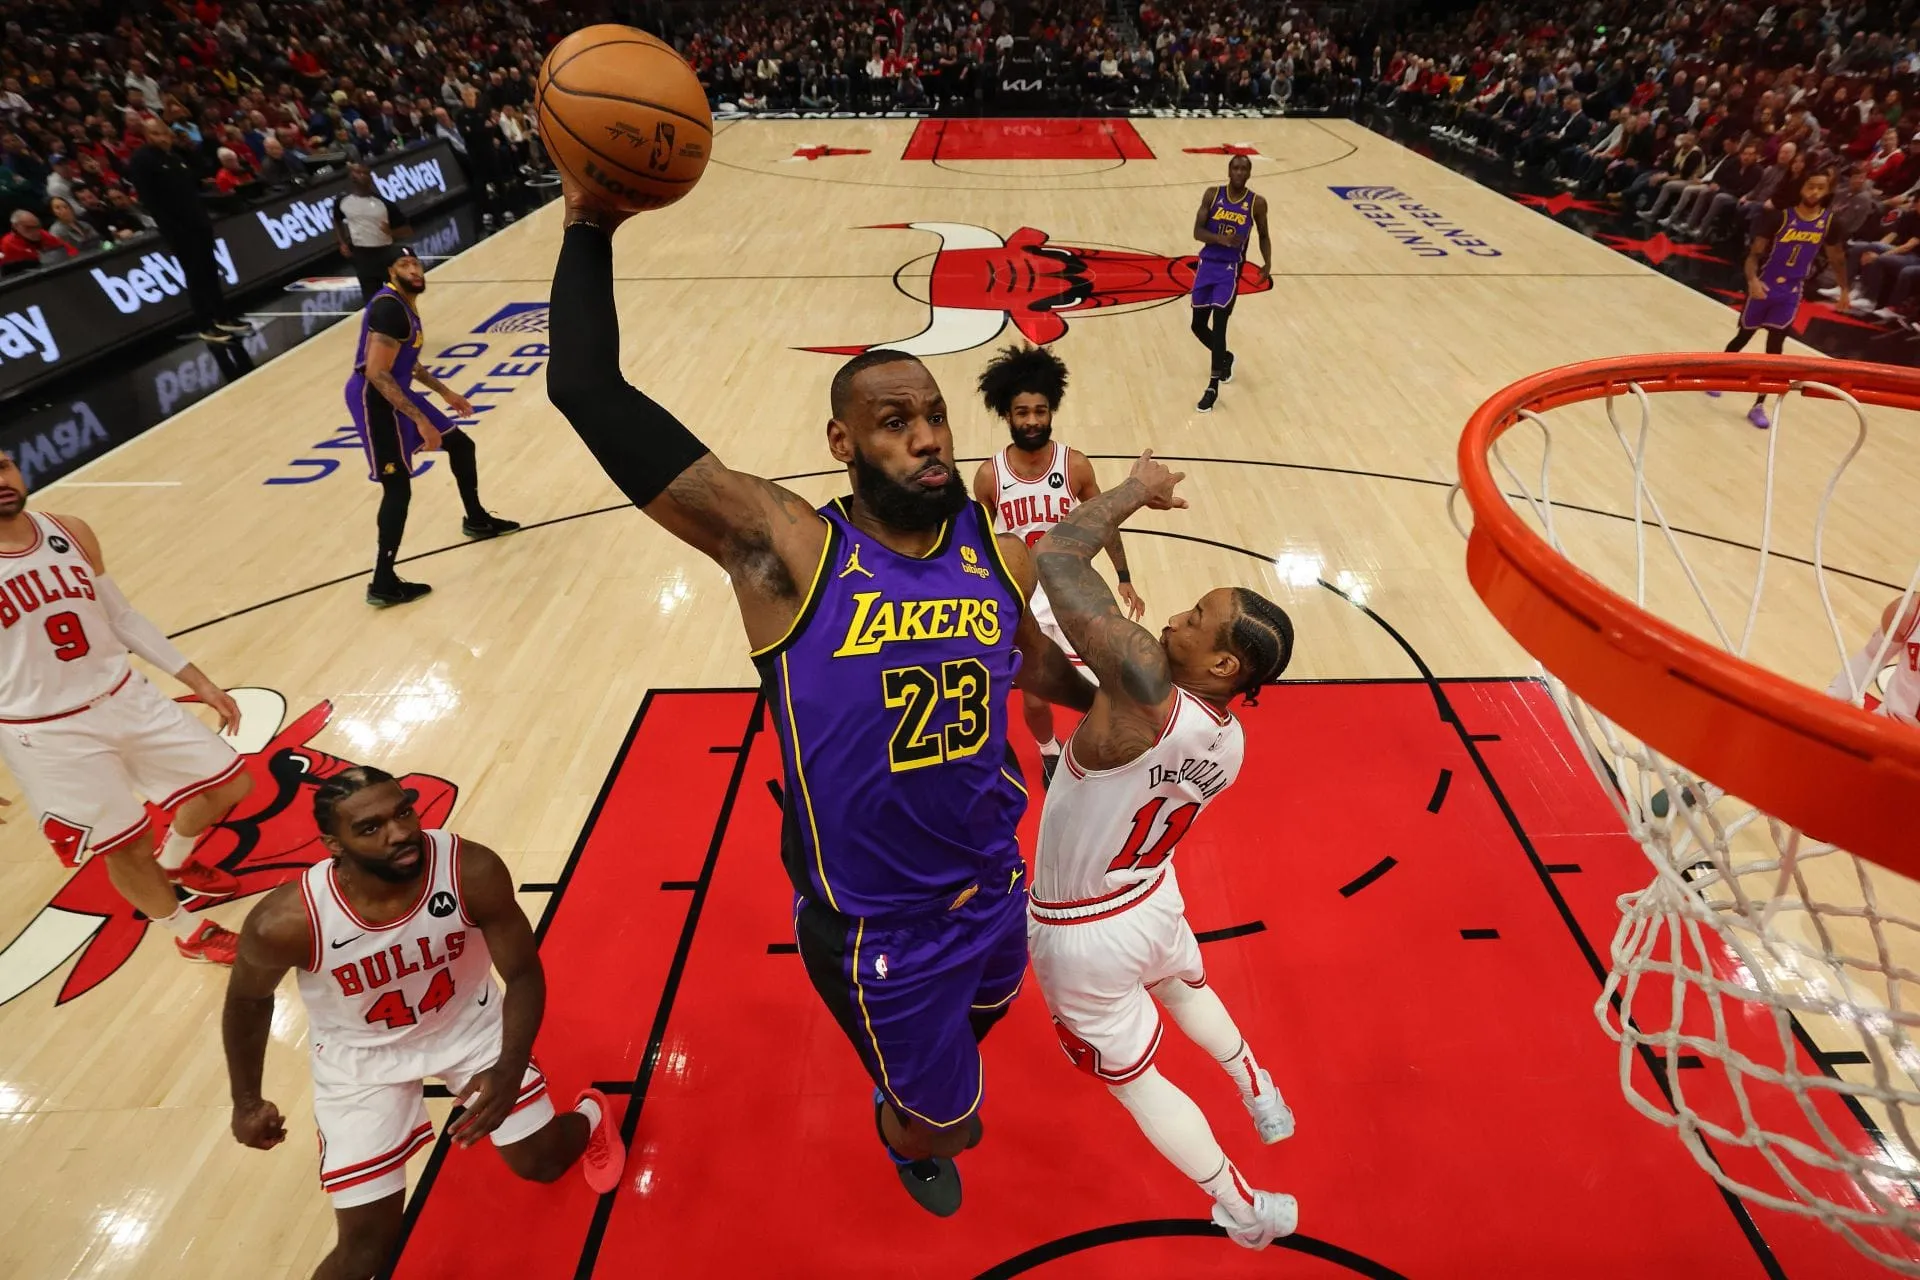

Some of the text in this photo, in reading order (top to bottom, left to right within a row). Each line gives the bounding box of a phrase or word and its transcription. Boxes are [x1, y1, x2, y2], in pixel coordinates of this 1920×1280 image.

[1002, 79, 1043, 91] KIA
[370, 158, 446, 203] betway
[256, 195, 336, 249] betw
[1212, 207, 1247, 225] LAKERS
[1353, 203, 1449, 257] UNITED
[1398, 204, 1503, 257] CENTER
[1785, 244, 1802, 267] 1
[1000, 494, 1071, 531] BULLS
[961, 562, 990, 579] bibigo
[44, 610, 91, 662] 9
[832, 591, 1001, 658] LAKERS
[881, 657, 990, 773] 23
[1104, 796, 1201, 876] 11
[331, 930, 466, 996] BULLS
[365, 966, 456, 1030] 44
